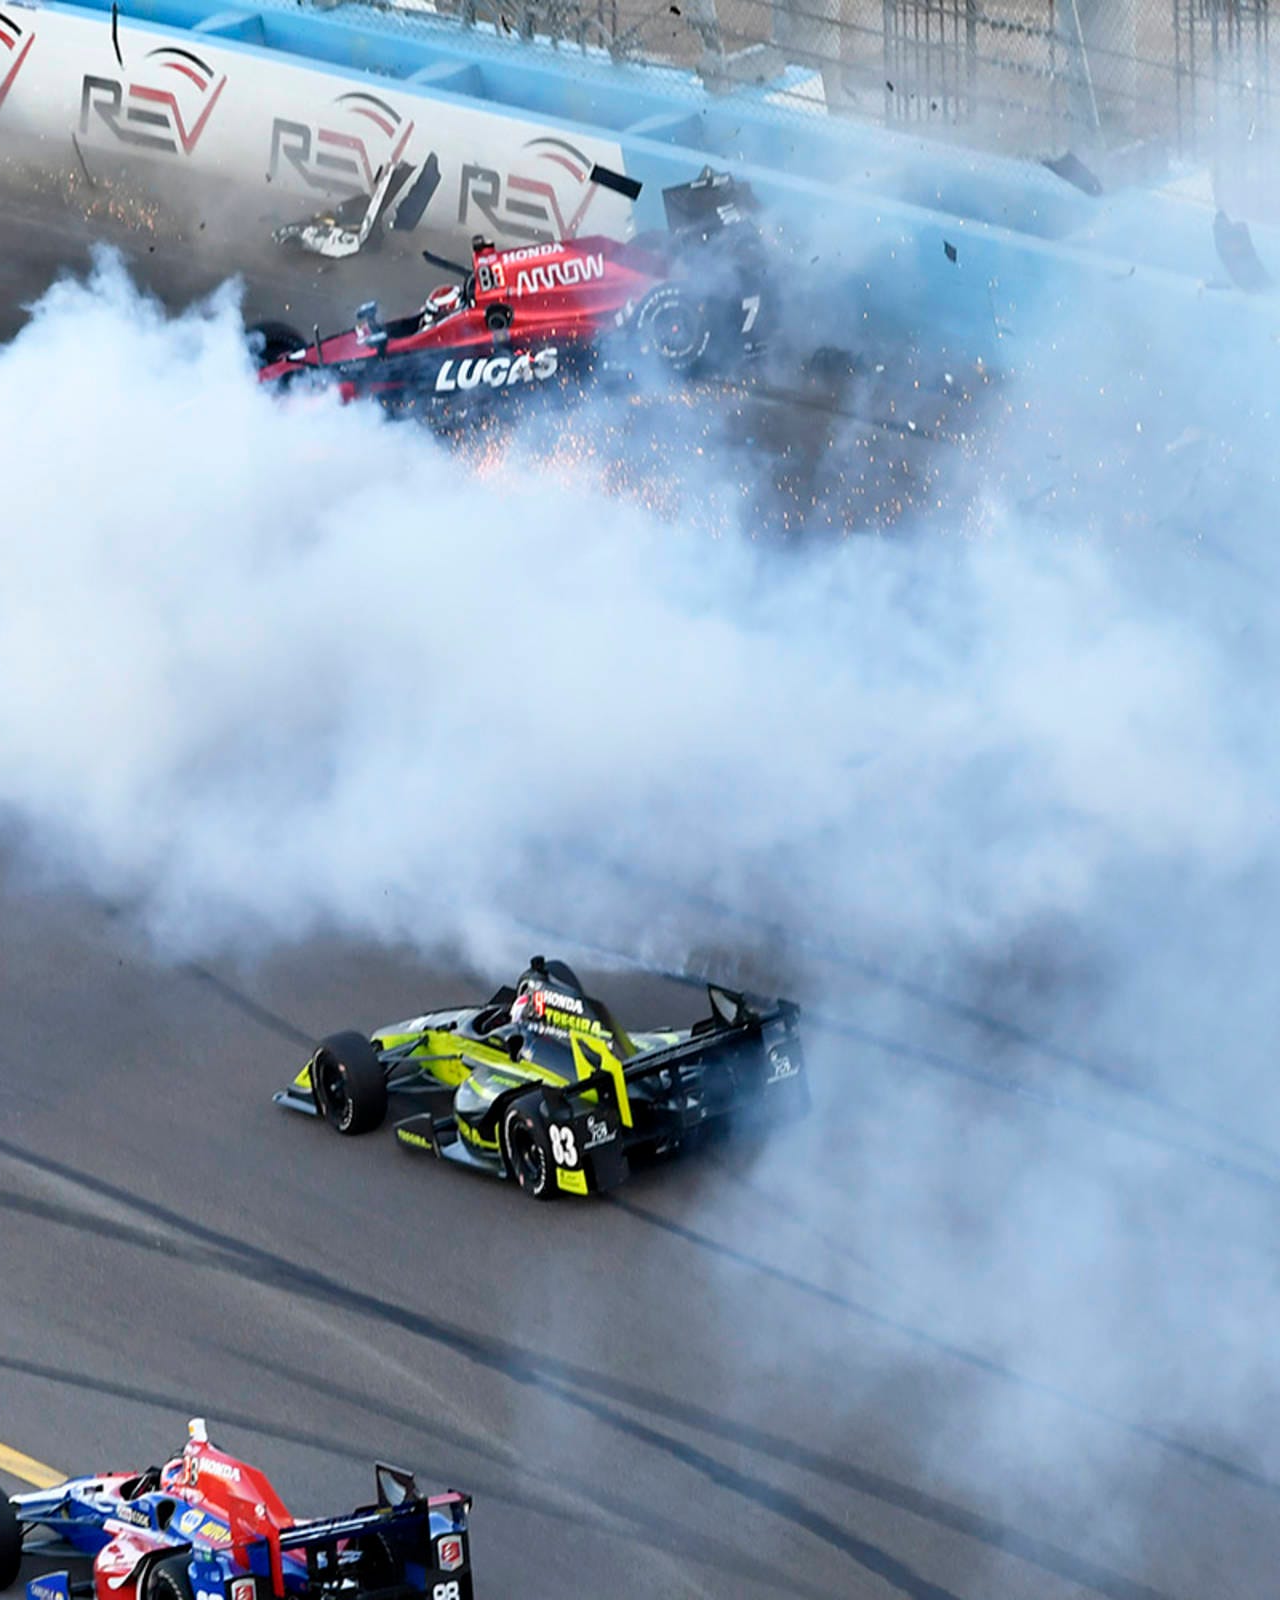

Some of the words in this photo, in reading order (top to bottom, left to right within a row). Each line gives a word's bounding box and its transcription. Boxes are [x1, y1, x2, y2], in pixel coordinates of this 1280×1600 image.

[79, 74, 228, 155] REV
[271, 117, 415, 197] REV
[458, 163, 598, 243] REV
[502, 242, 565, 265] HONDA
[516, 252, 606, 298] ARROW
[741, 295, 761, 333] 7
[434, 346, 559, 392] LUCAS
[543, 989, 584, 1015] HONDA
[549, 1123, 579, 1168] 83
